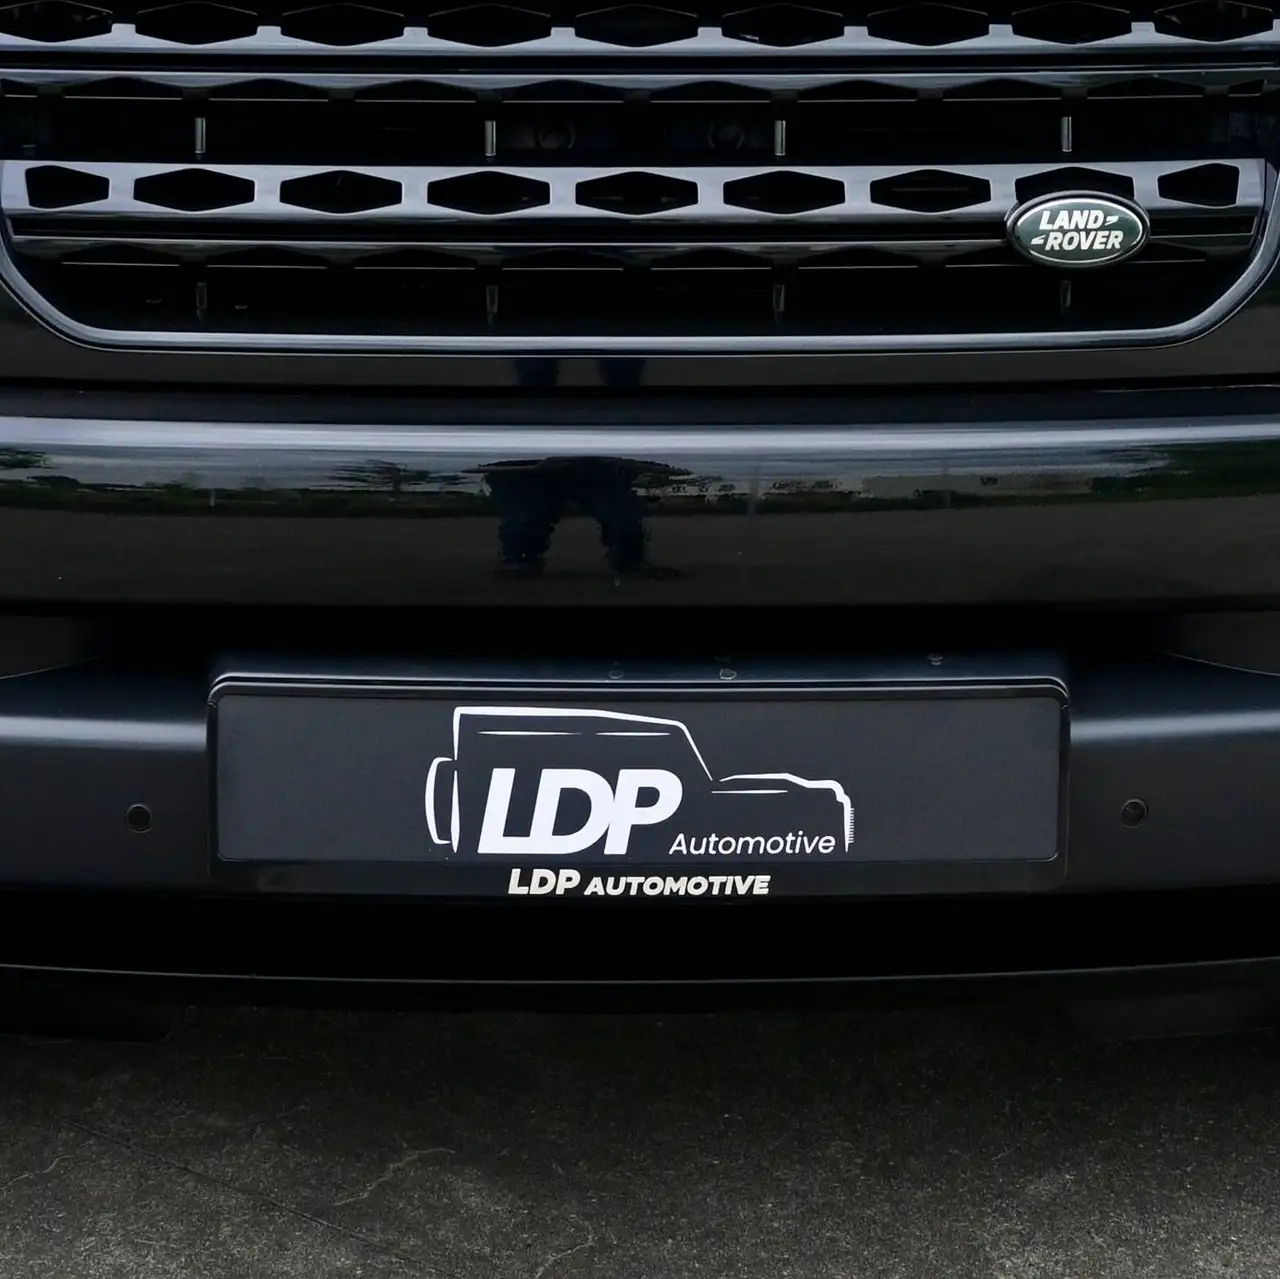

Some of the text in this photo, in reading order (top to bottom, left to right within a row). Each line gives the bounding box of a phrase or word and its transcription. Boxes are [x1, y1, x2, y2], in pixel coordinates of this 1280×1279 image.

[1038, 209, 1104, 231] LAND
[1044, 230, 1124, 251] ROVER
[477, 767, 836, 855] LDP Automotive
[507, 868, 772, 896] LDP AUTOMOTIVE
